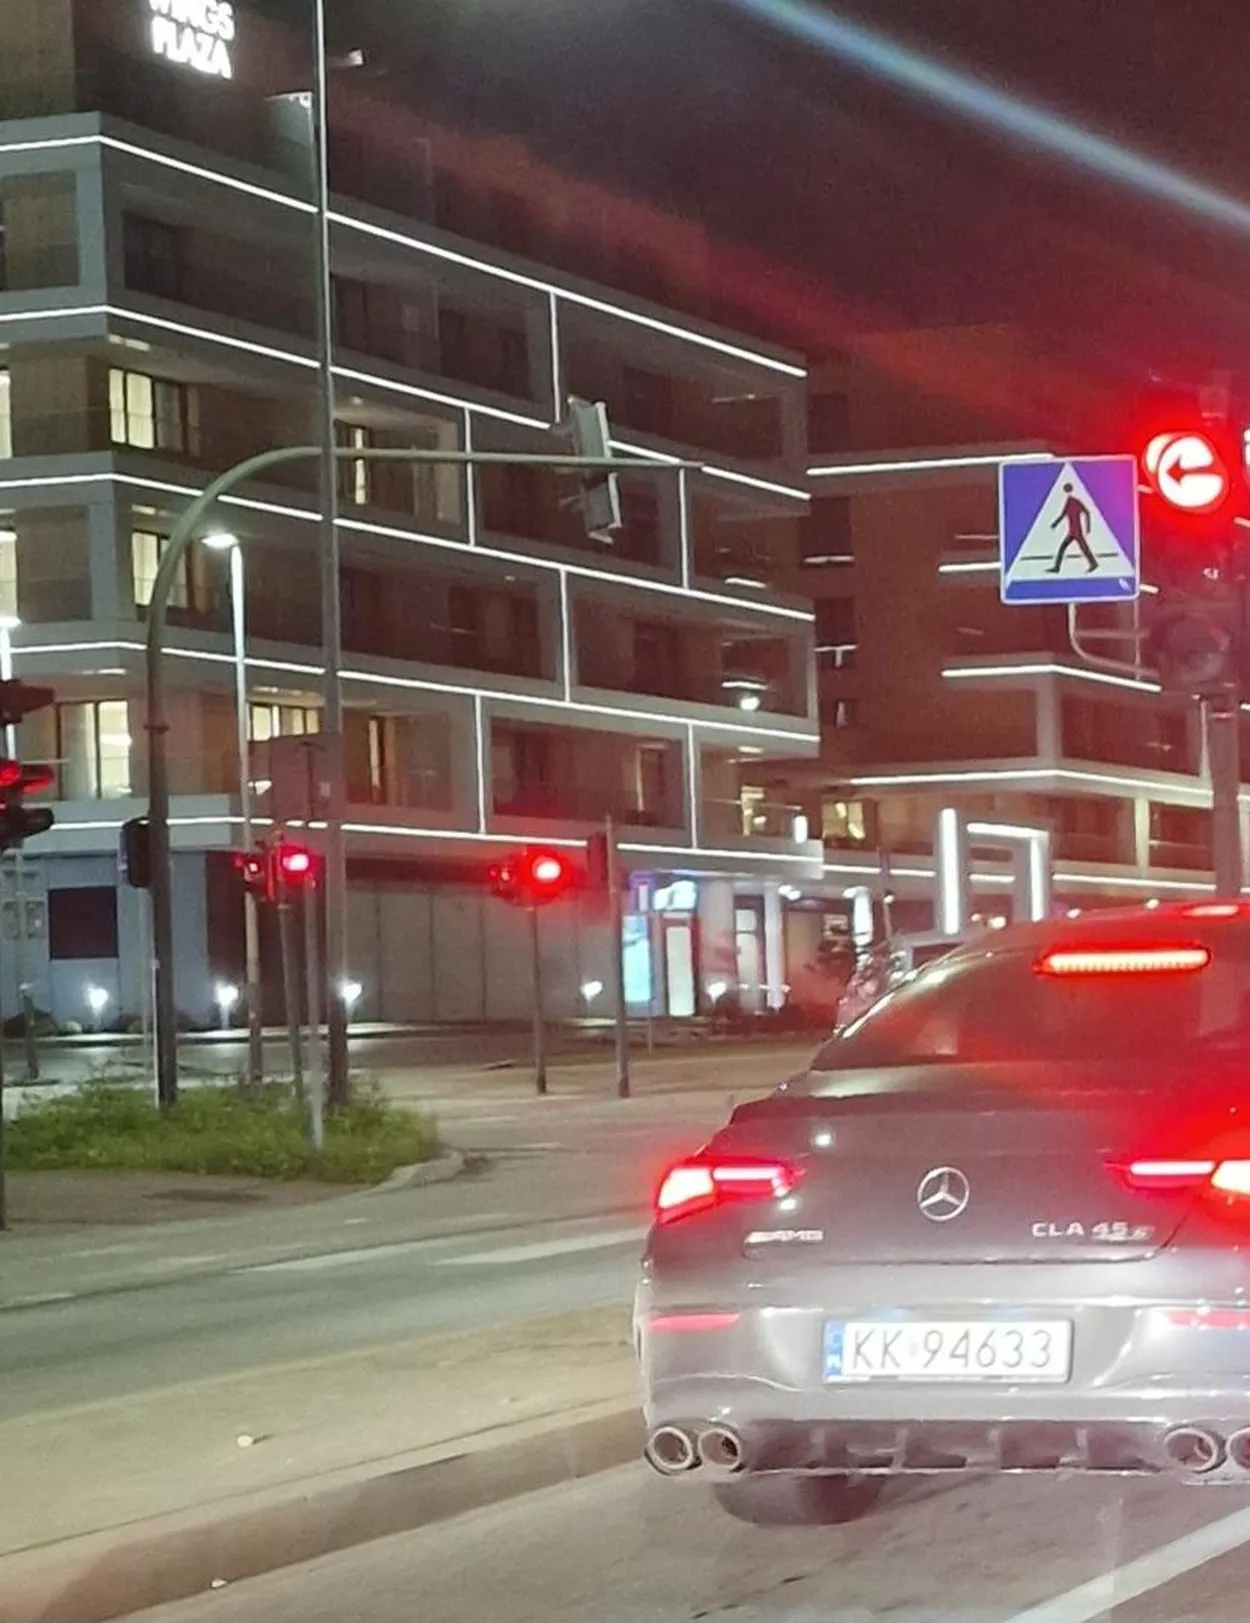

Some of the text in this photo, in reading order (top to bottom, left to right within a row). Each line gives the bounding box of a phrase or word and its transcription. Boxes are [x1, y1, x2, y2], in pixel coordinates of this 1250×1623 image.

[152, 16, 232, 79] PLAZA
[1031, 1221, 1085, 1238] CLA
[852, 1327, 1053, 1370] KK 94633
